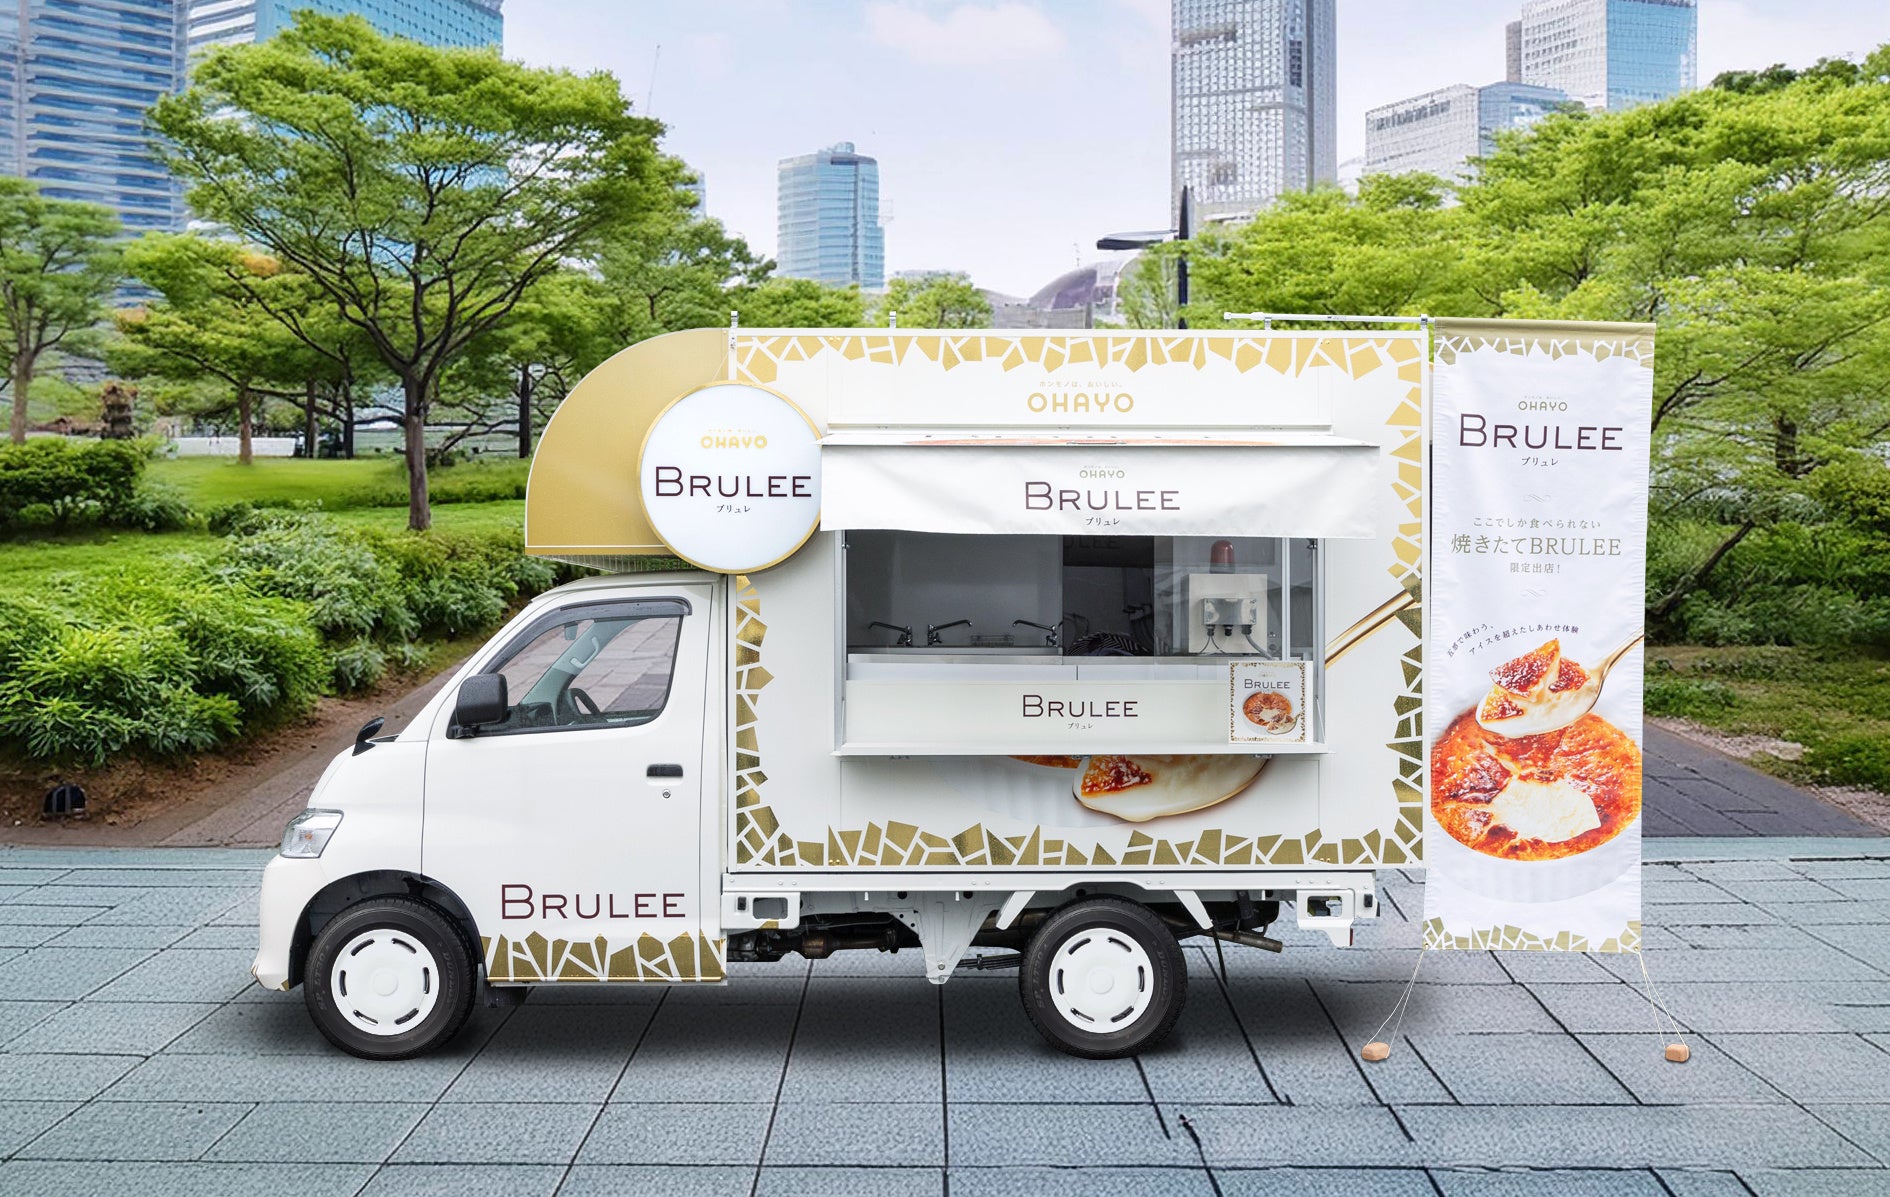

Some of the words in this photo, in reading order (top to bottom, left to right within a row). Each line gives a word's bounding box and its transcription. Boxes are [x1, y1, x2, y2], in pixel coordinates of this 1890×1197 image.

[1027, 392, 1134, 413] OHAYO
[1517, 400, 1568, 412] OHAYO
[1459, 412, 1624, 451] BRULEE
[700, 435, 768, 449] OHAYO
[1521, 456, 1559, 467] ブリュレ
[655, 466, 812, 498] BRULEE
[1079, 469, 1125, 479] OHAYO
[1024, 481, 1181, 511] BRULEE
[716, 504, 751, 514] ブリュレ
[1085, 517, 1121, 527] ブリュレ
[1473, 517, 1601, 530] ここでしか食べられない
[1451, 533, 1622, 556] 焼きたてBRULEE
[1022, 694, 1139, 718] BRULEE
[501, 883, 686, 920] BRULEE
